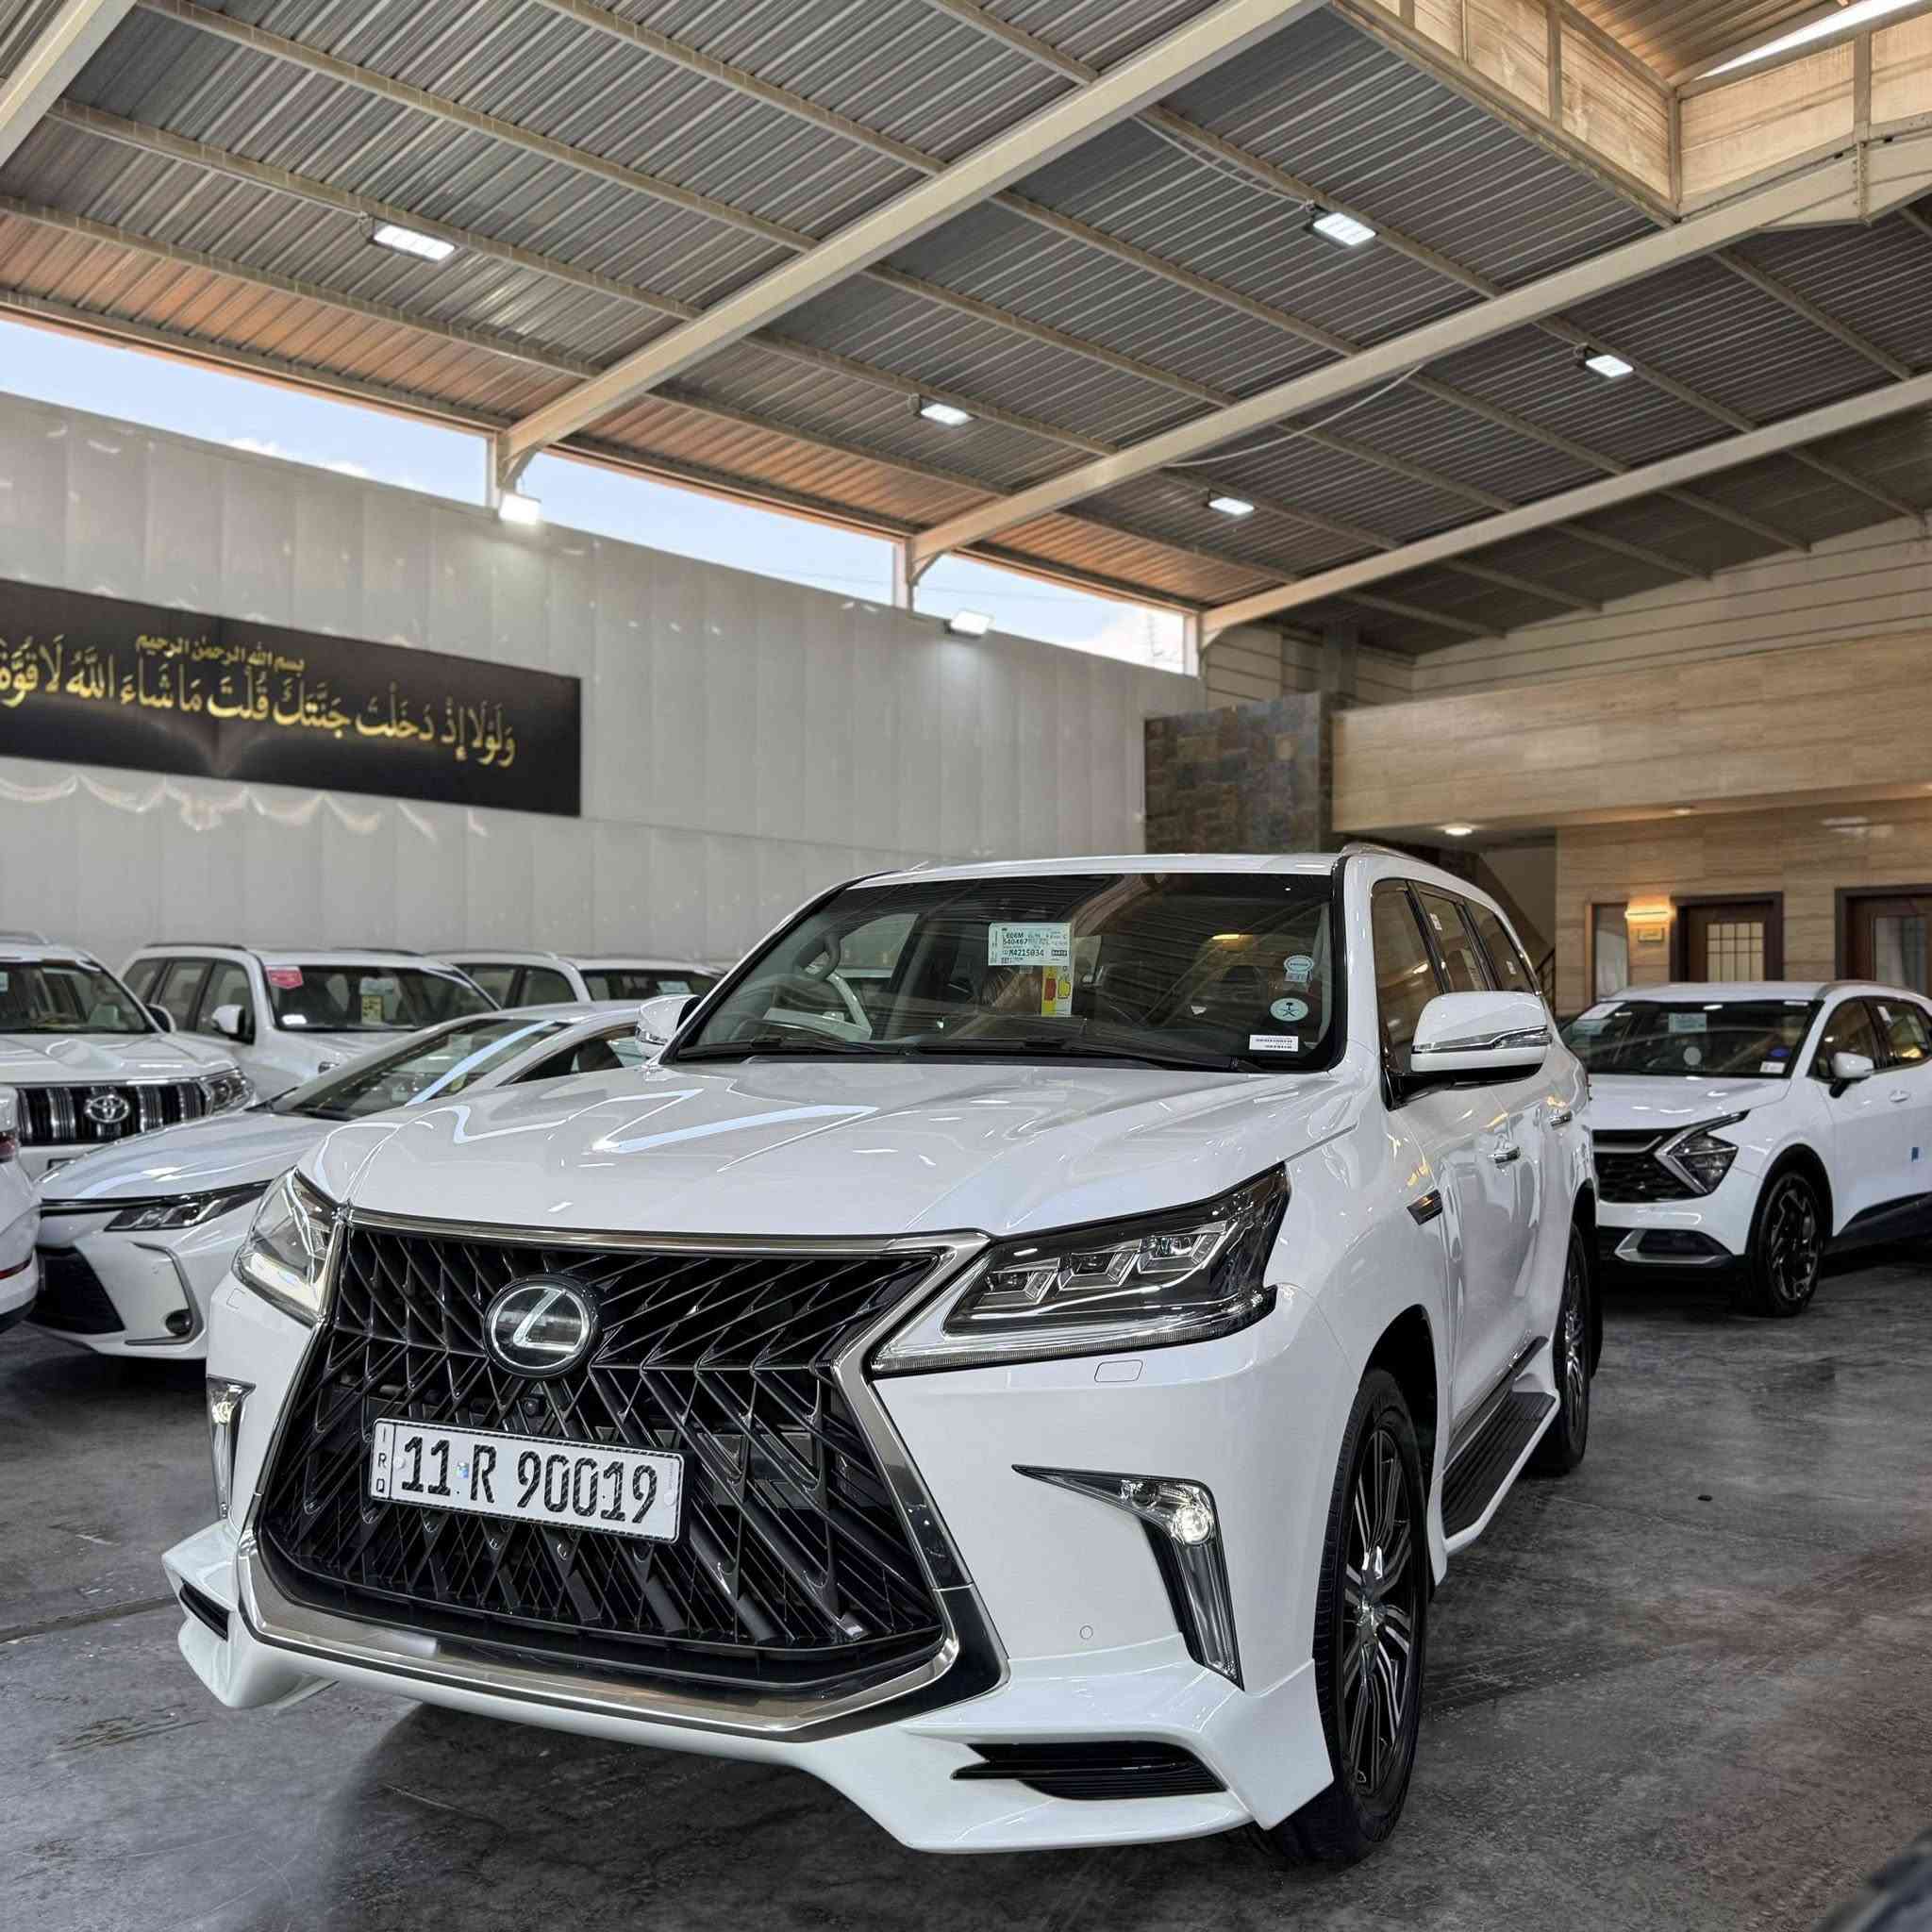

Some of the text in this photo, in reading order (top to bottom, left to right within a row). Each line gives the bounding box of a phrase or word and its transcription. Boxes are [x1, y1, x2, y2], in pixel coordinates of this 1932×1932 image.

[375, 1427, 387, 1494] IRQ
[401, 1435, 451, 1497] 11
[470, 1443, 497, 1504] R
[516, 1449, 658, 1524] 90019
